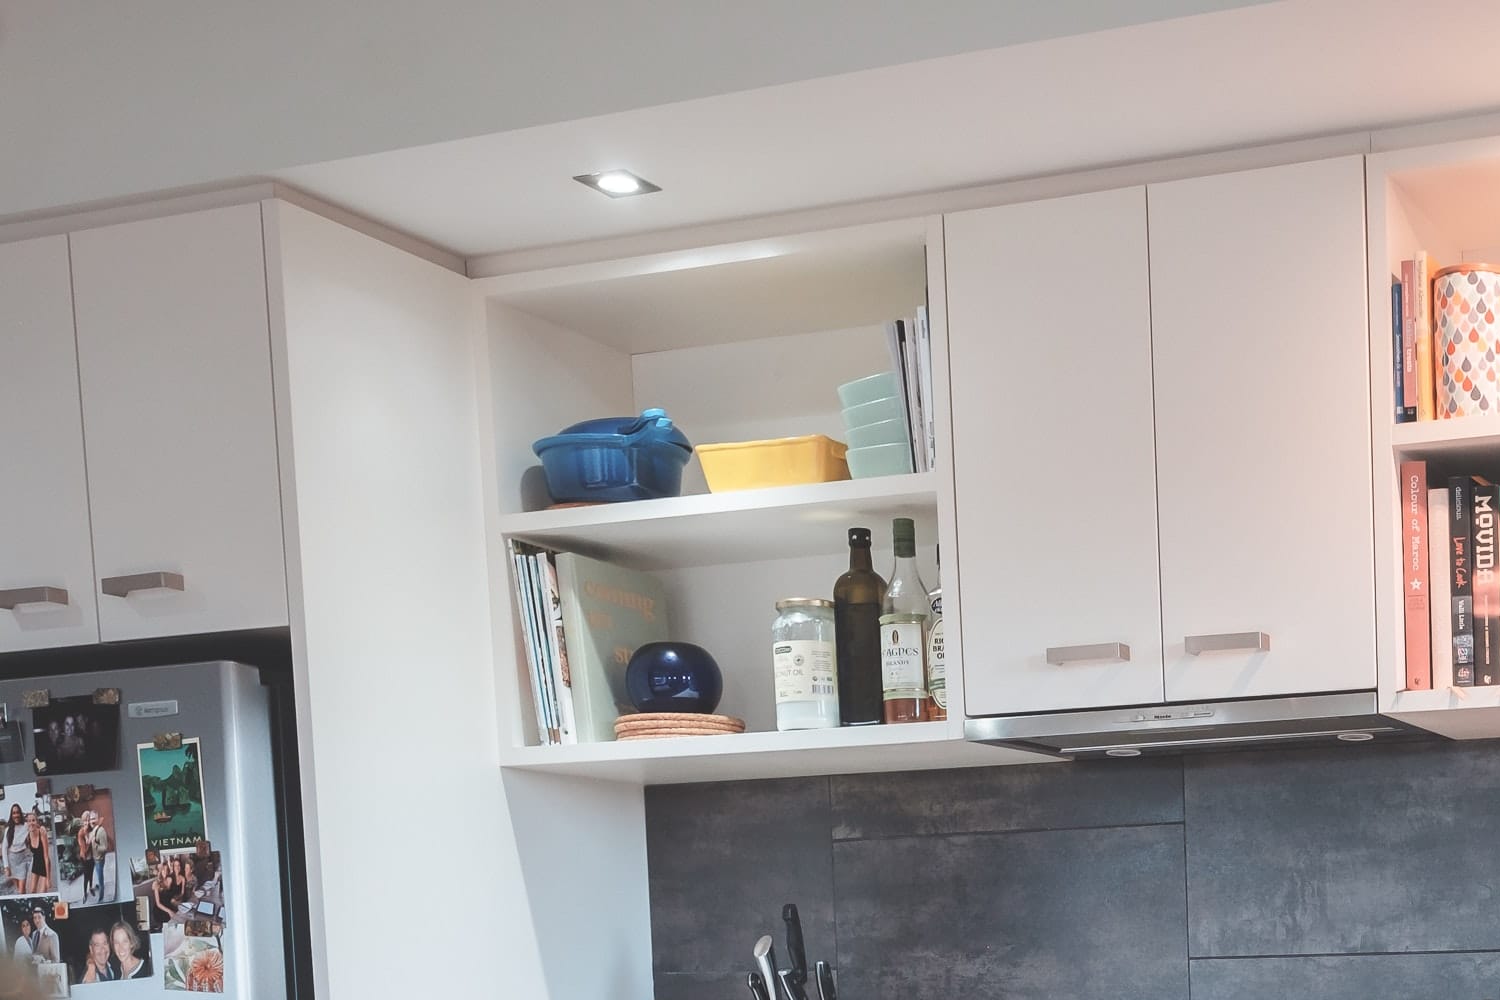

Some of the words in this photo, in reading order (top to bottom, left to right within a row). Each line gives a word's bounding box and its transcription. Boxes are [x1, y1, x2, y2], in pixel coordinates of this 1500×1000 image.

[1410, 474, 1419, 515] Colour
[1411, 519, 1420, 531] of
[1411, 536, 1420, 570] Maroc
[1452, 536, 1467, 556] Love
[1455, 557, 1466, 566] to
[150, 835, 202, 848] VIETNAM
